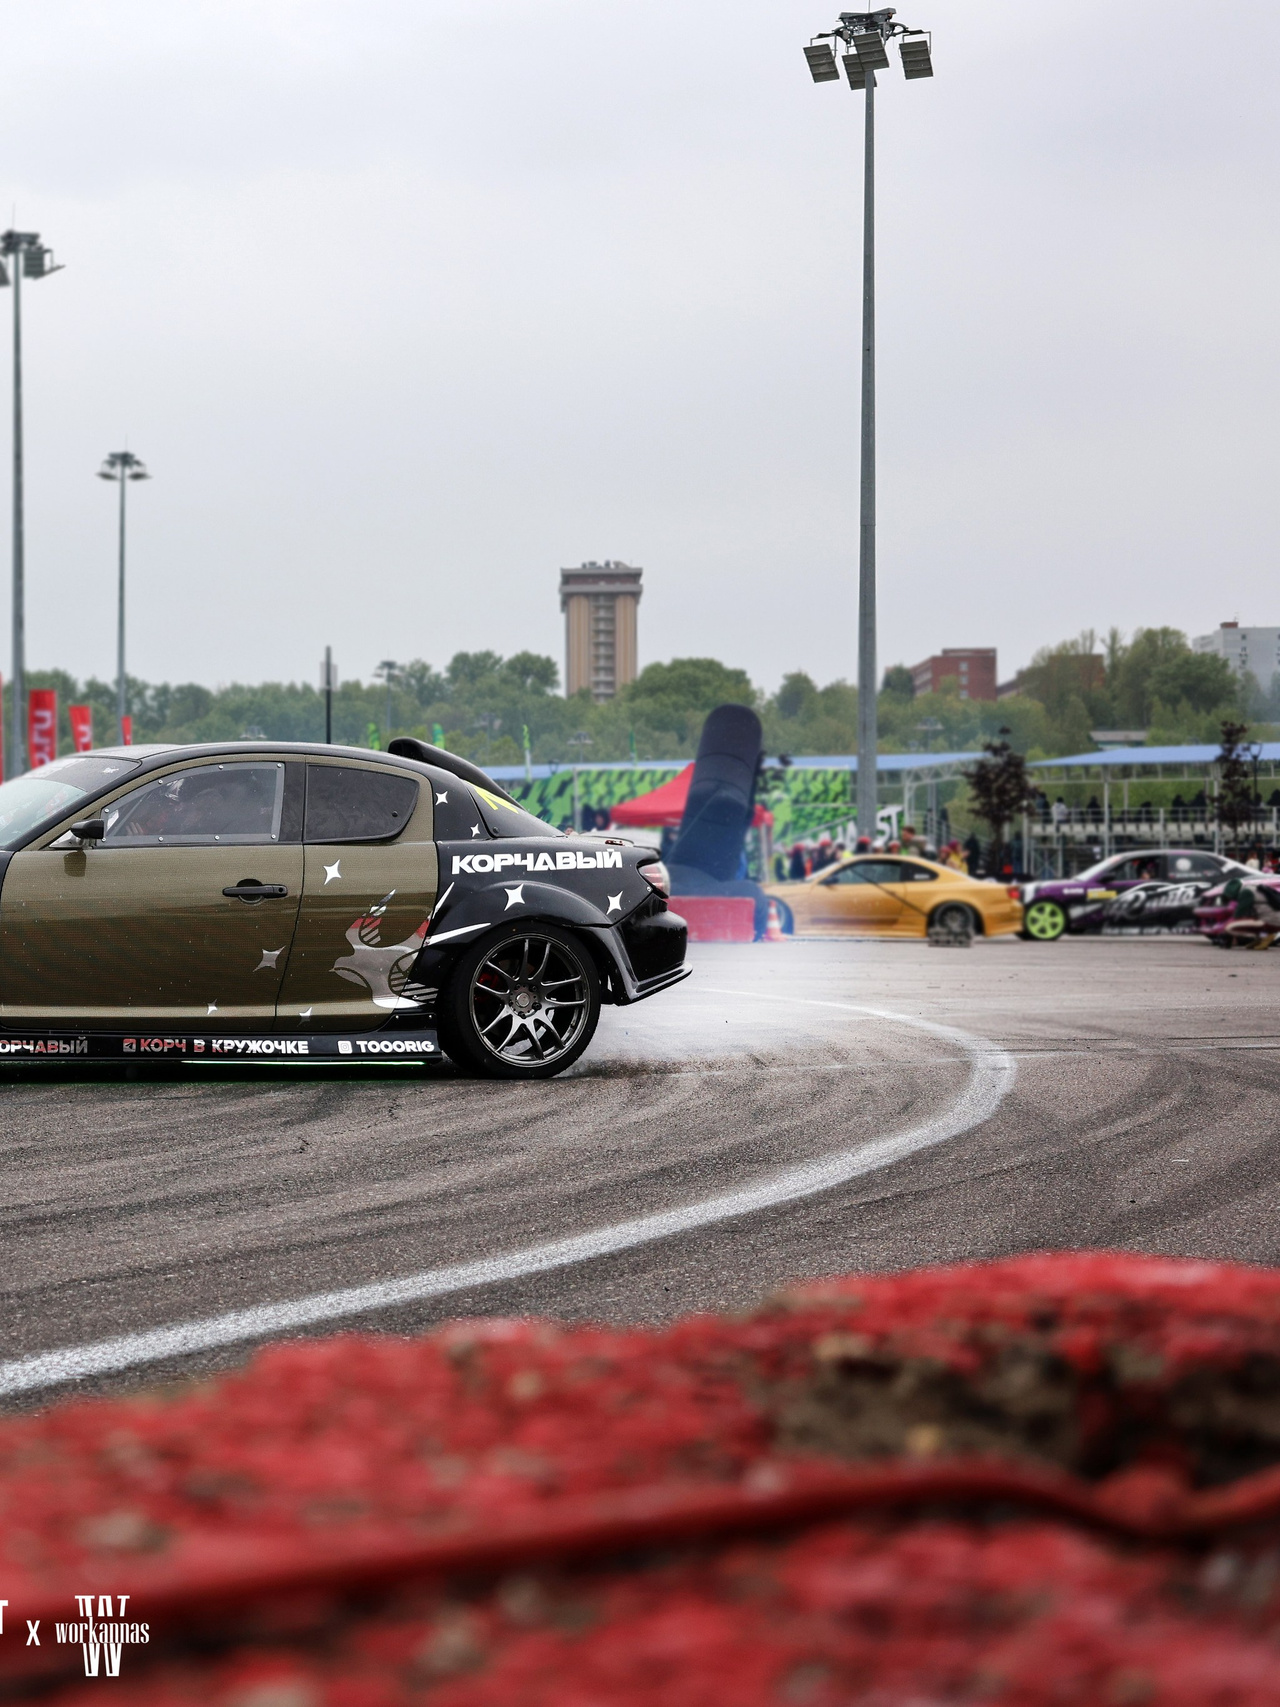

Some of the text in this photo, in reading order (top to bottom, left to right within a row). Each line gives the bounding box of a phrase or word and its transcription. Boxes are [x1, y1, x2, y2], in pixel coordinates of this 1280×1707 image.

[452, 848, 622, 875] КОРЧАВЫЙ
[140, 1038, 310, 1054] КОРЧ В КРУЖОЧКЕ
[356, 1040, 435, 1053] TOOORIG
